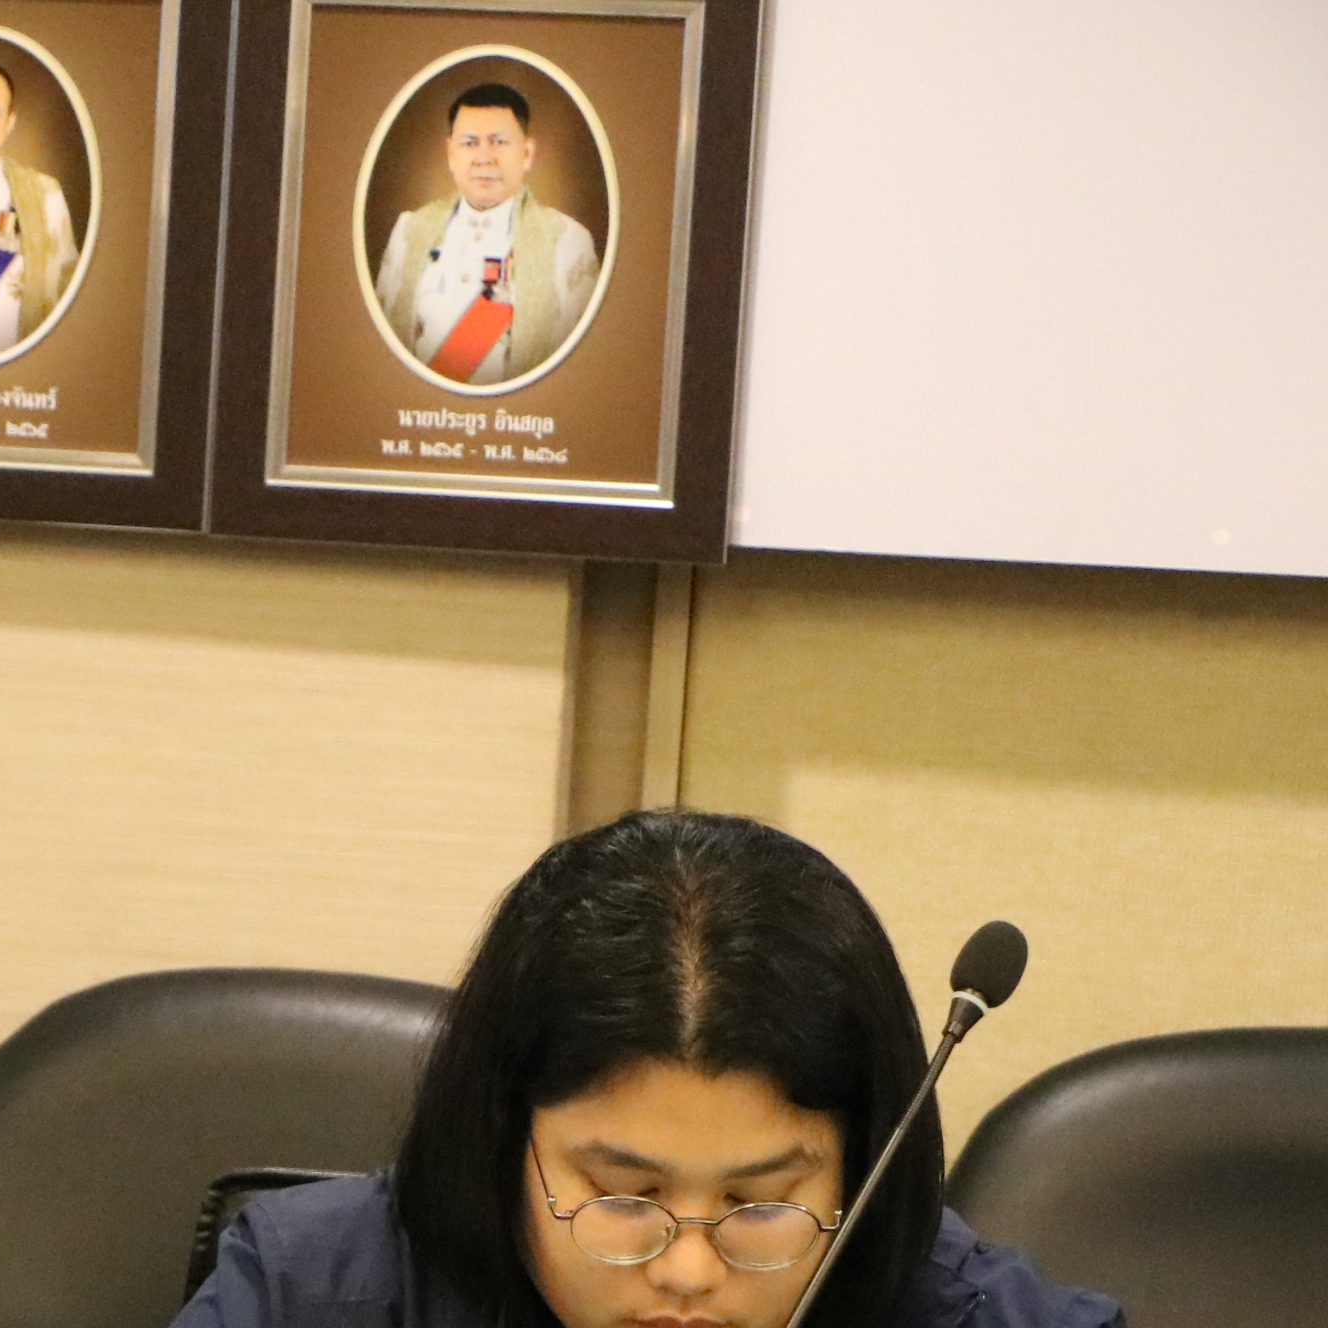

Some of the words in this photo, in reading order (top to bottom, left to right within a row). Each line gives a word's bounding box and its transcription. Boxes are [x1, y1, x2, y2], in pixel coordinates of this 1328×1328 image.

[397, 407, 487, 437] นายประยูร
[495, 408, 555, 440] อินสกุล
[381, 438, 413, 455] พ.ศ.
[483, 443, 516, 460] พ.ศ.
